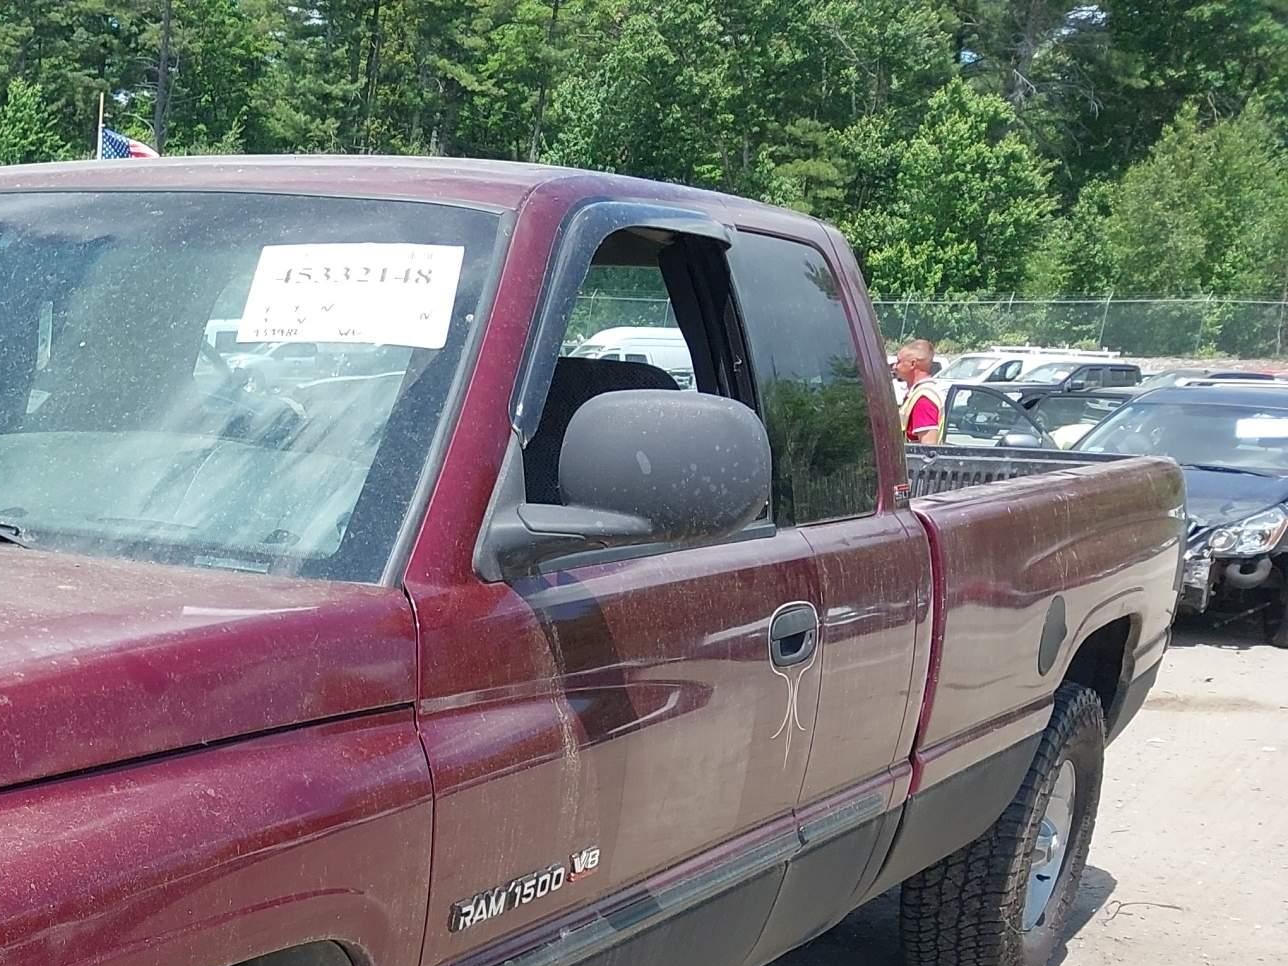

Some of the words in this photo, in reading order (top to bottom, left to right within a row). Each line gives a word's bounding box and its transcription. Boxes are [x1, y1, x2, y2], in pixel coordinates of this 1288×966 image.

[275, 267, 433, 285] 45332148
[454, 889, 507, 931] RAM
[511, 865, 566, 909] 1500
[571, 848, 601, 875] V8
